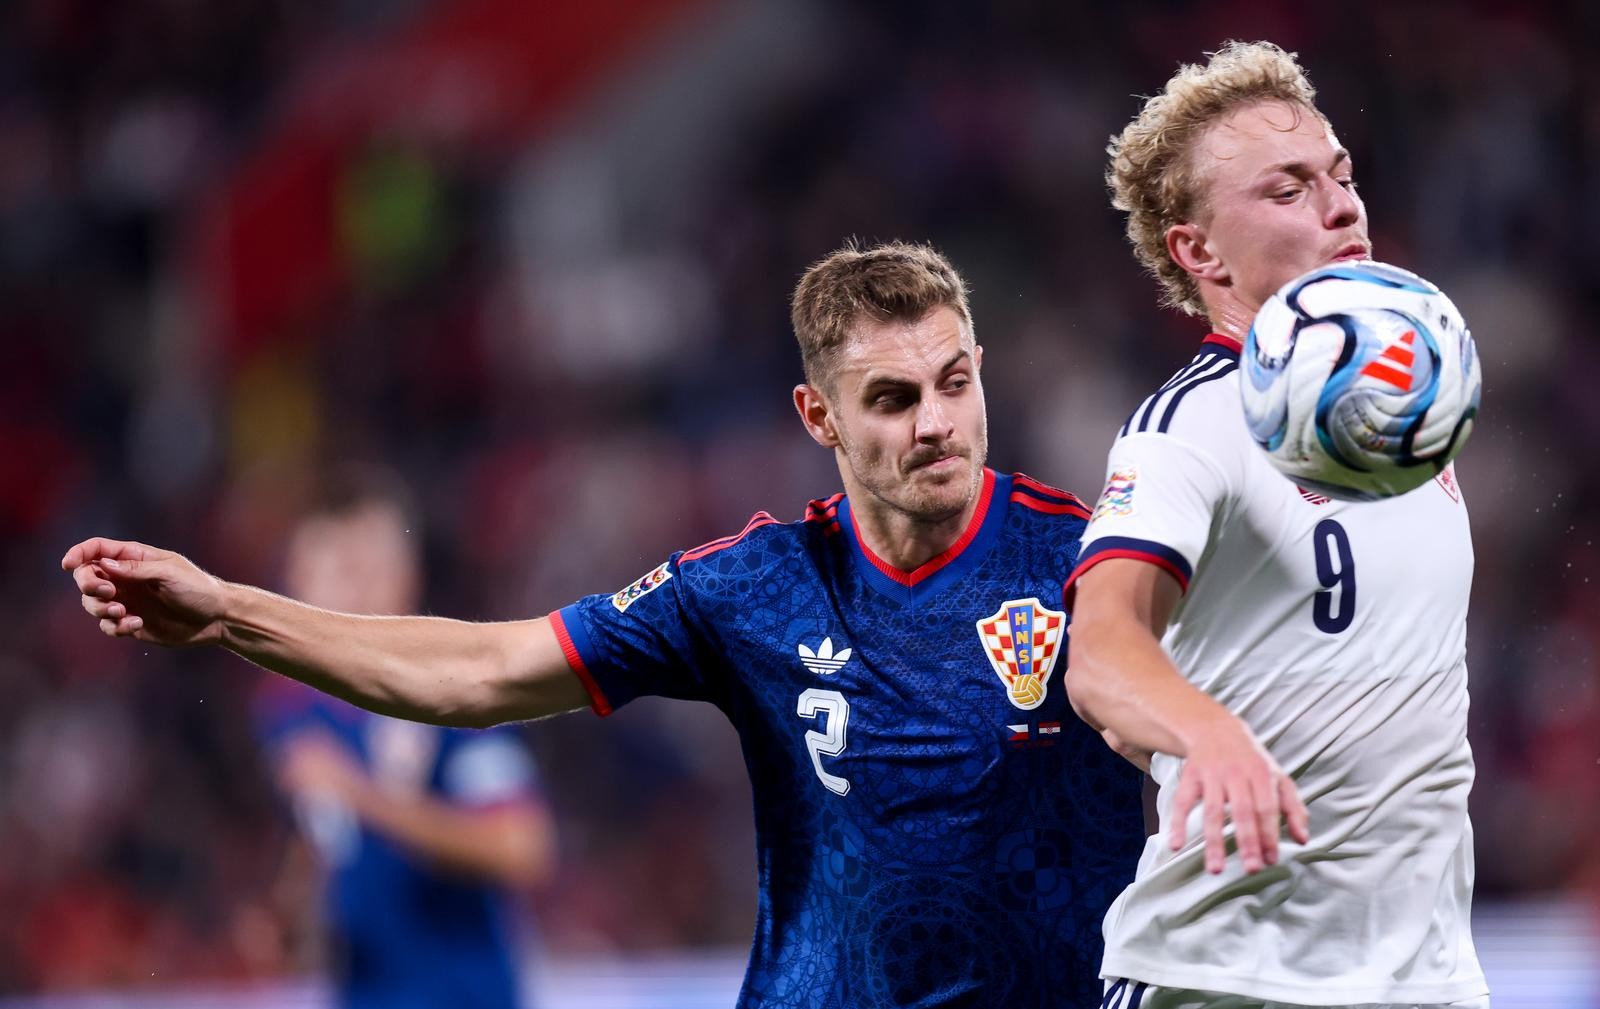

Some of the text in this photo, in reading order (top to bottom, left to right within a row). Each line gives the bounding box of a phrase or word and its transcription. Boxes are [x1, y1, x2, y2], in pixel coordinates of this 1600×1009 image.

[1313, 518, 1356, 634] 9
[1014, 612, 1030, 664] HNS
[797, 687, 851, 797] 2
